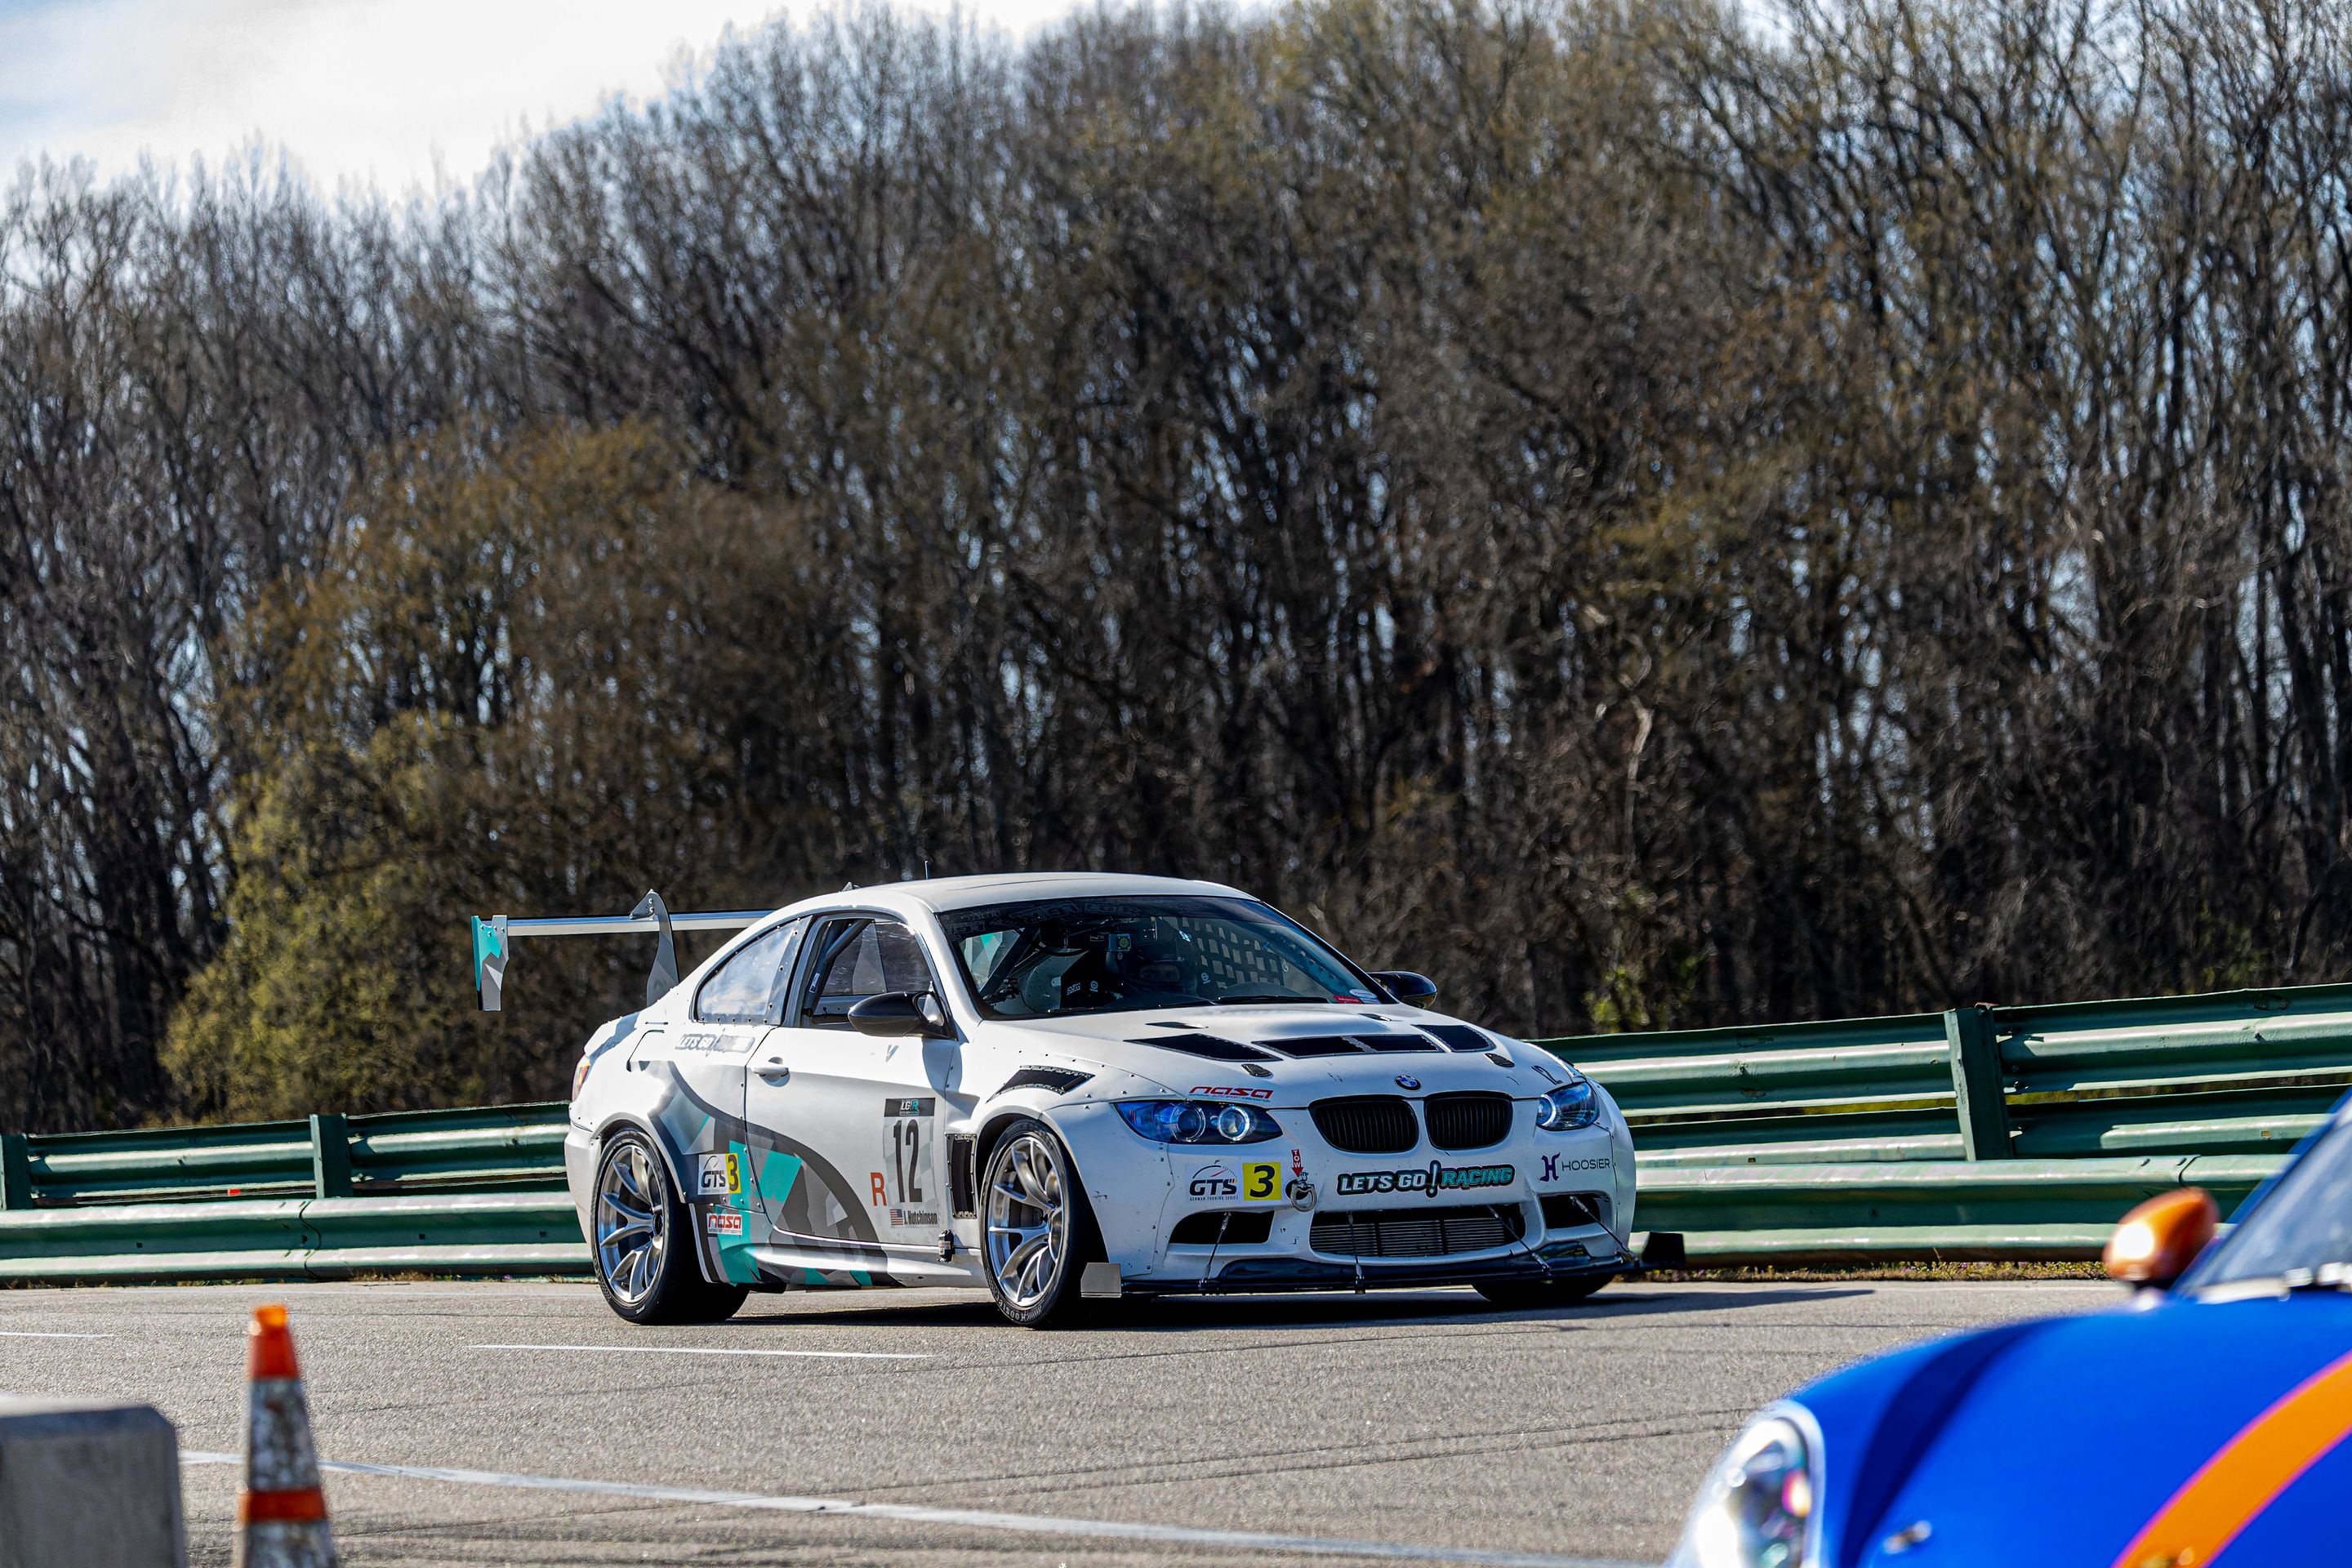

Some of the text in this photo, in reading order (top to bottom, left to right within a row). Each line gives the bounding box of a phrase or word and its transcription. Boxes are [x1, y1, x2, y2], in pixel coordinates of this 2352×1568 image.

[1530, 1065, 1564, 1085] 12
[702, 1154, 739, 1192] GTS 3
[893, 1120, 922, 1202] 12
[1293, 1150, 1301, 1168] TOW
[1561, 1158, 1610, 1171] HOOSIER
[870, 1172, 887, 1206] R
[1189, 1165, 1275, 1197] GTS 3
[1340, 1174, 1392, 1192] LETS
[1441, 1168, 1513, 1187] RACING
